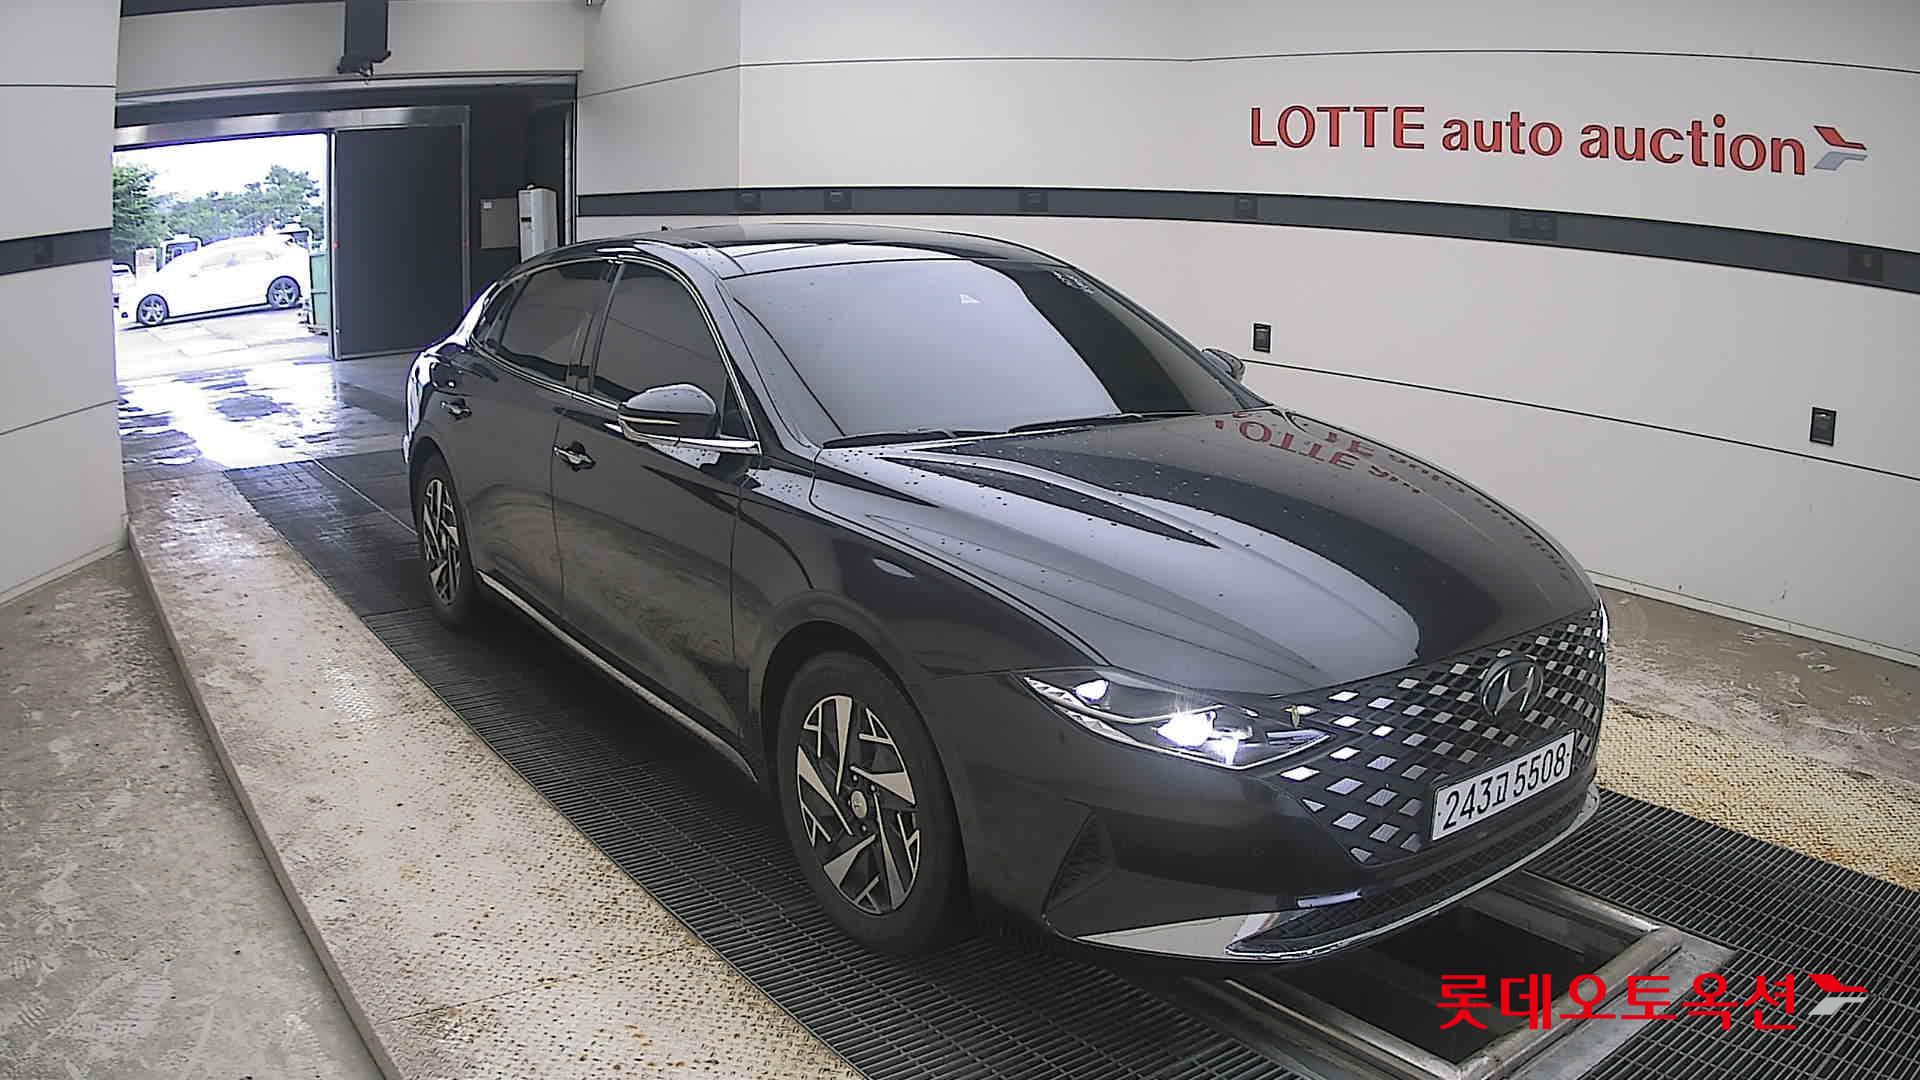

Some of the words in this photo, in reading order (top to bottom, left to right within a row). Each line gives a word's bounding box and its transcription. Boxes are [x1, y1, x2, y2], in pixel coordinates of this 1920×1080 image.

[1251, 105, 1425, 150] LOTTE
[1442, 111, 1563, 157] auto
[1579, 114, 1807, 176] auction
[1443, 774, 1509, 831] 243고
[1513, 742, 1566, 797] 5508
